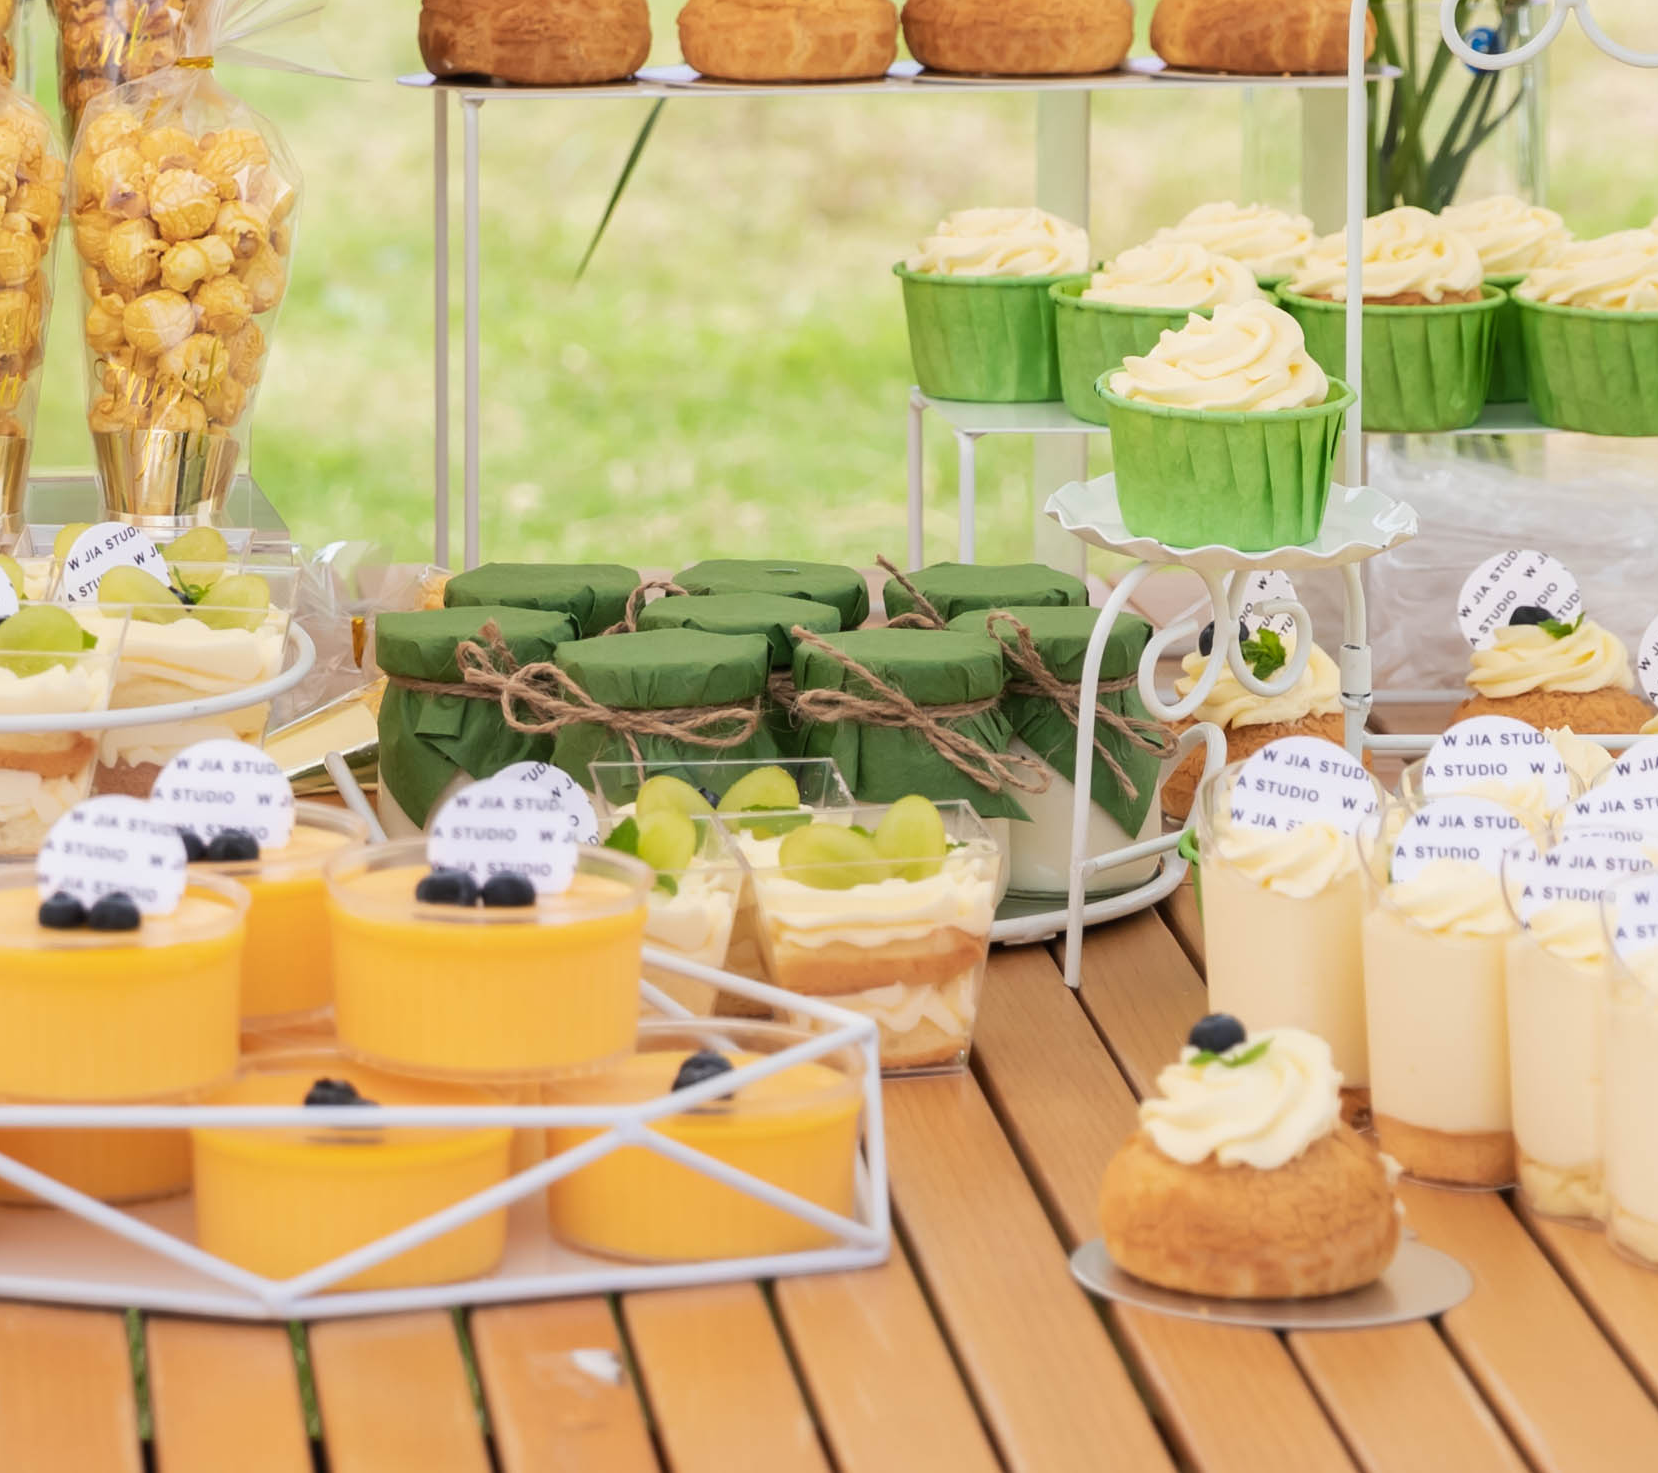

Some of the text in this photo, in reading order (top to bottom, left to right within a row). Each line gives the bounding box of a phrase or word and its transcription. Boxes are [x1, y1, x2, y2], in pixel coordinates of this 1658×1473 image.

[68, 526, 140, 571] W JIA STUD
[133, 552, 146, 566] W
[1523, 566, 1537, 578] W
[1460, 550, 1522, 618] W JIA STUD
[1479, 590, 1518, 634] STUDIO
[1638, 657, 1652, 671] W
[1442, 732, 1550, 747] W JIA STUD
[176, 757, 282, 776] W JIA STUD
[1263, 748, 1369, 782] W JIA STUD
[1444, 762, 1546, 777] STUDIO W
[1616, 762, 1632, 776] W
[171, 789, 274, 807] STUDIO W
[1255, 779, 1358, 811] STUDIO W
[456, 796, 565, 812] W JIA STUD
[1575, 802, 1591, 816] W
[1599, 800, 1626, 814] JIA
[71, 811, 119, 829] W JIA
[1229, 807, 1277, 829] W JIA
[1415, 814, 1525, 830] W JIA STUD
[451, 827, 556, 842] STUDIO W
[63, 841, 165, 868] STUDIO W
[1415, 845, 1481, 861] STUDIO
[1545, 854, 1560, 867] W
[1569, 855, 1597, 870] JIA
[58, 876, 85, 892] JIA
[1634, 891, 1650, 904] W
